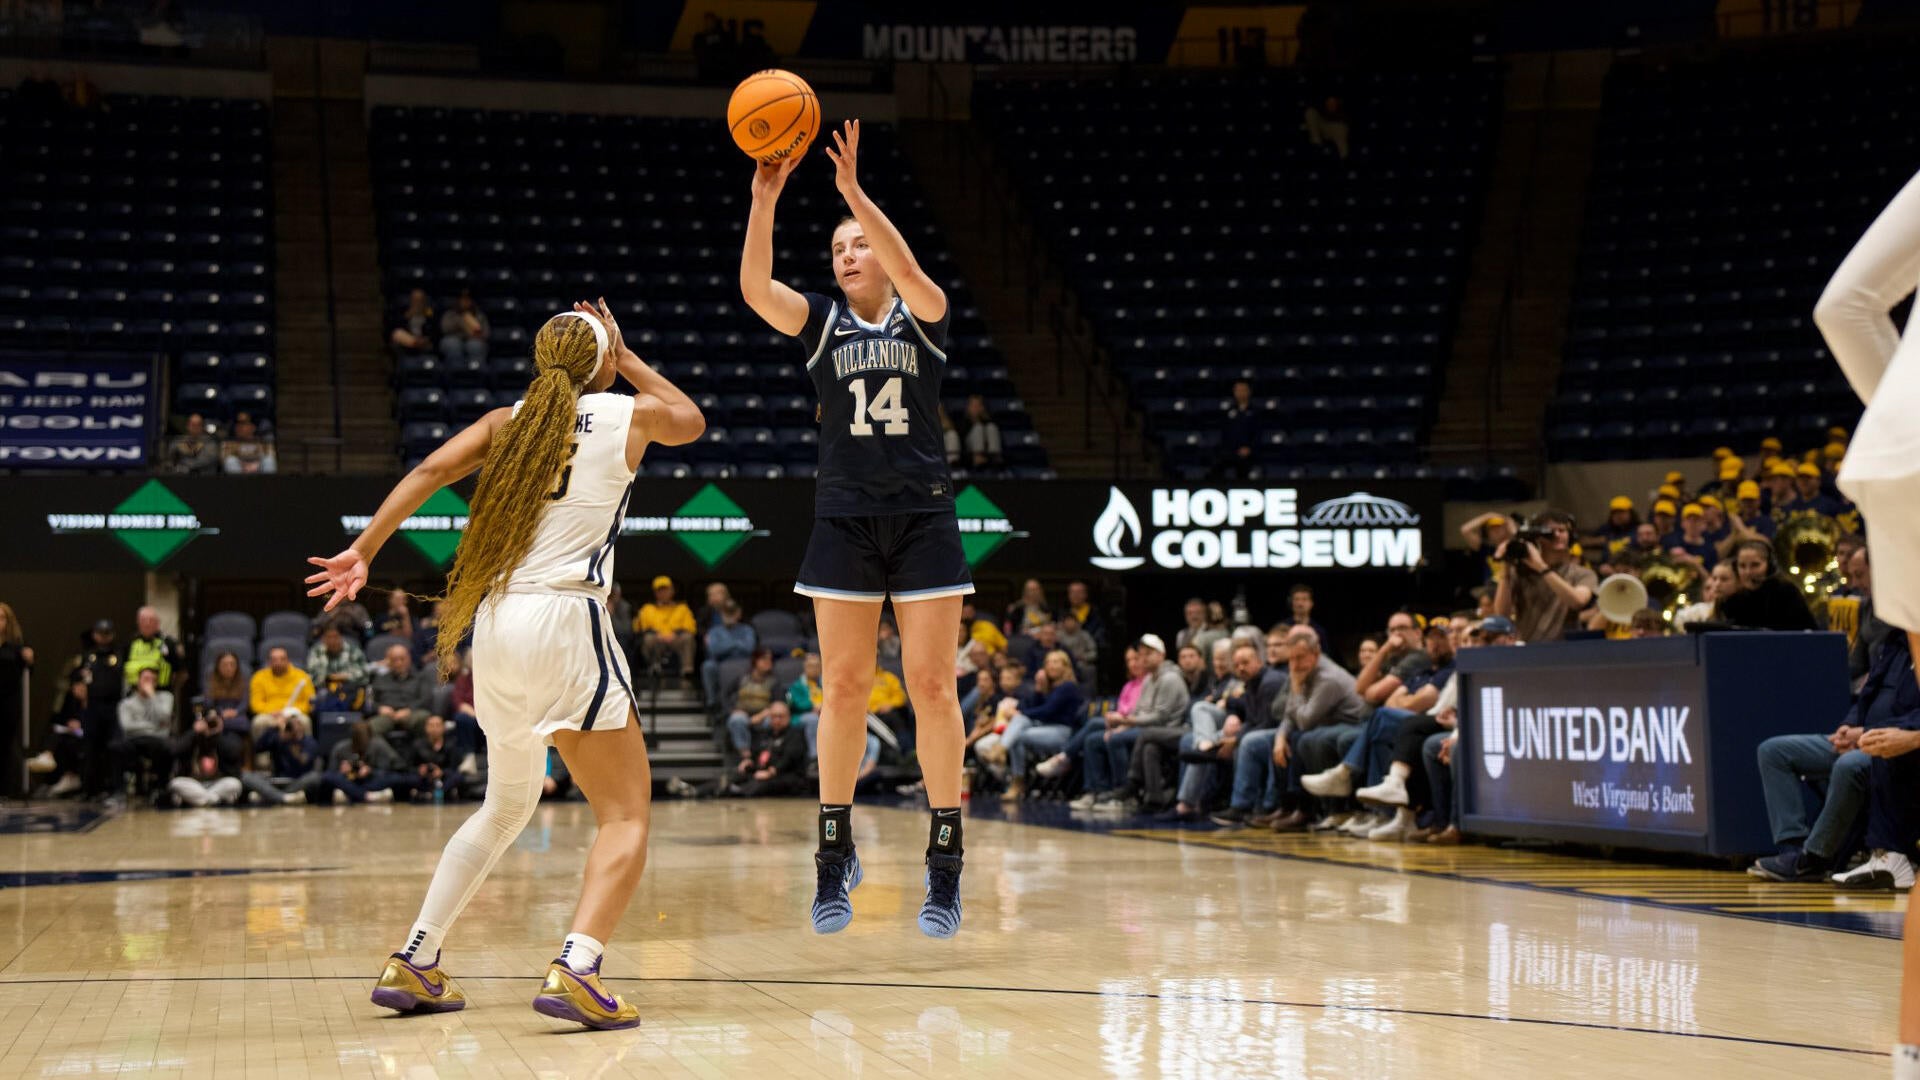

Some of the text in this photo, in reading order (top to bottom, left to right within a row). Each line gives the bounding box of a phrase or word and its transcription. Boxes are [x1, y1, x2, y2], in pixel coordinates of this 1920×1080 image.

[832, 339, 920, 380] VILLANOVA
[21, 394, 83, 408] JEEP
[89, 394, 146, 408] RAM
[848, 377, 910, 436] 14
[0, 414, 144, 429] COLN
[1152, 489, 1298, 527] HOPE
[1151, 529, 1422, 569] COLISEUM
[1507, 706, 1692, 763] UNITED BANK
[1572, 781, 1694, 818] West Virginia's Bank
